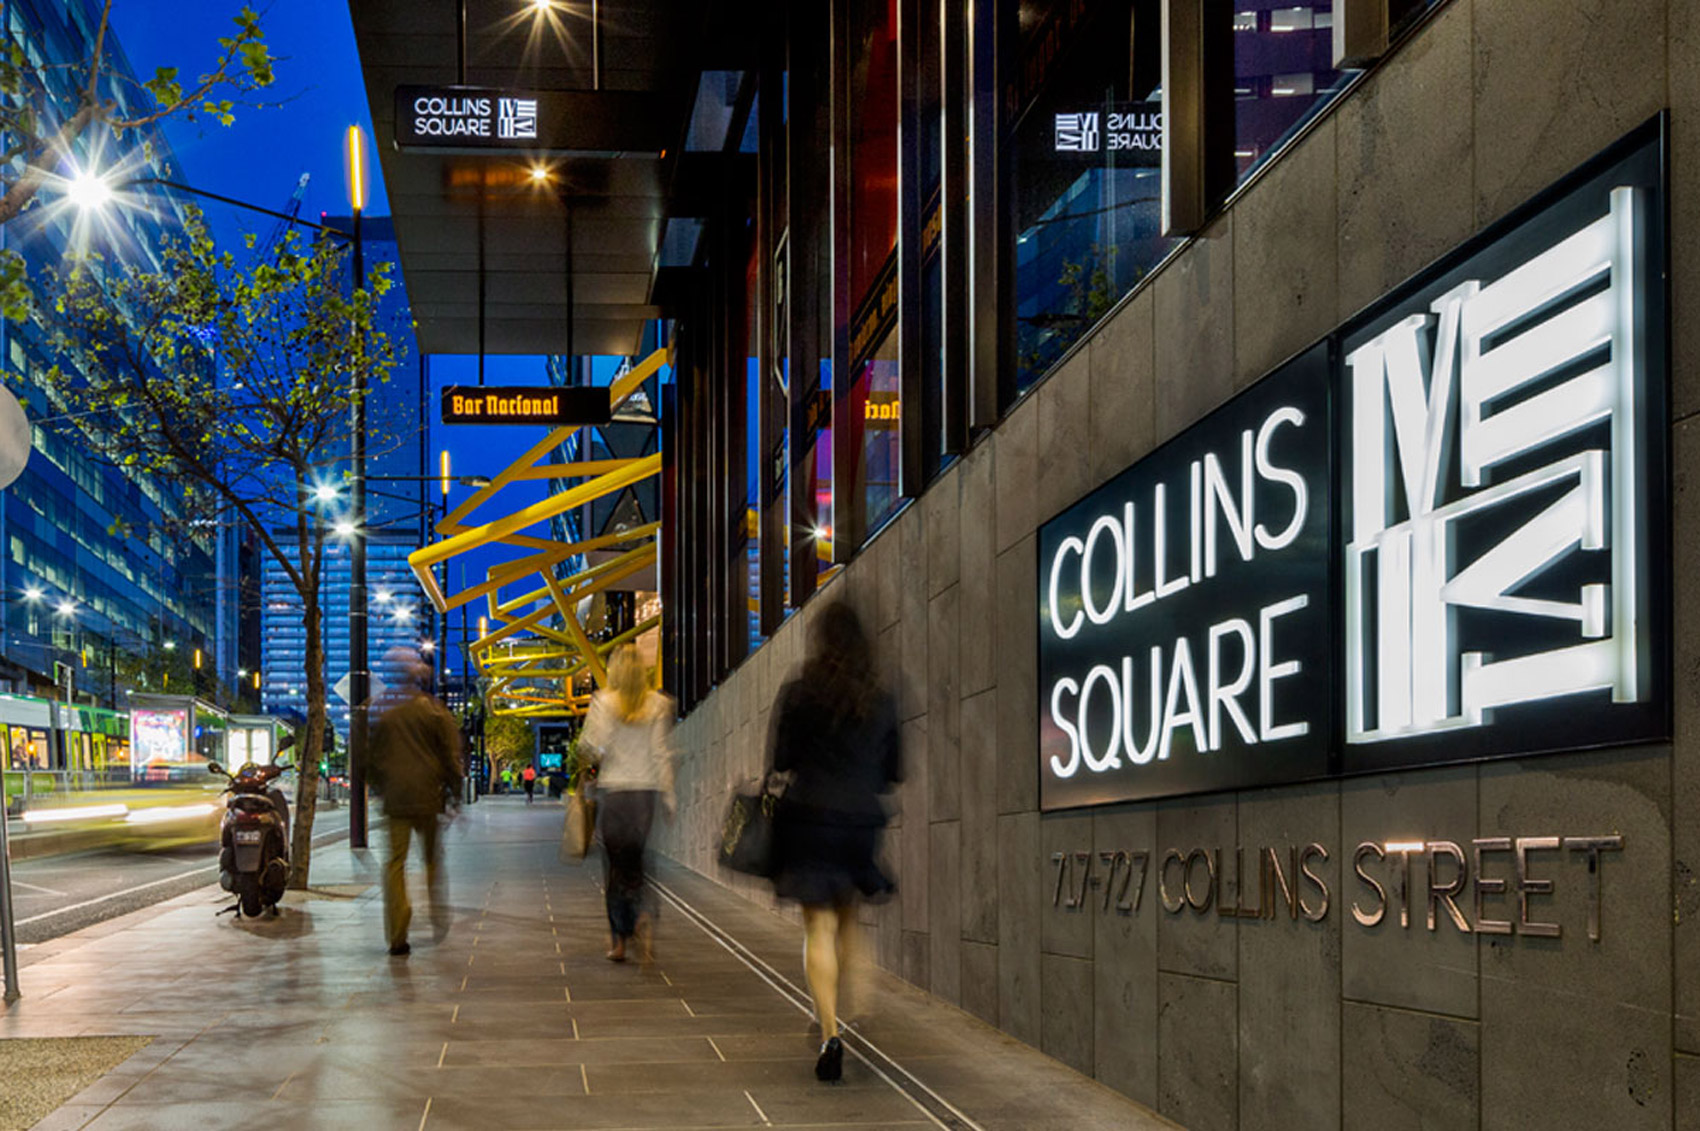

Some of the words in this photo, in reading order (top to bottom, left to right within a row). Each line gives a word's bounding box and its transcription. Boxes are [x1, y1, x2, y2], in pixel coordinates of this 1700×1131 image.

[414, 98, 491, 116] COLLINS
[414, 118, 491, 136] SQUARE
[452, 395, 483, 415] Bar
[1048, 406, 1308, 639] COLLINS
[1049, 594, 1309, 778] SQUARE
[1052, 849, 1150, 914] 717-727
[1159, 842, 1330, 923] COLLINS
[1351, 835, 1624, 943] STREET
